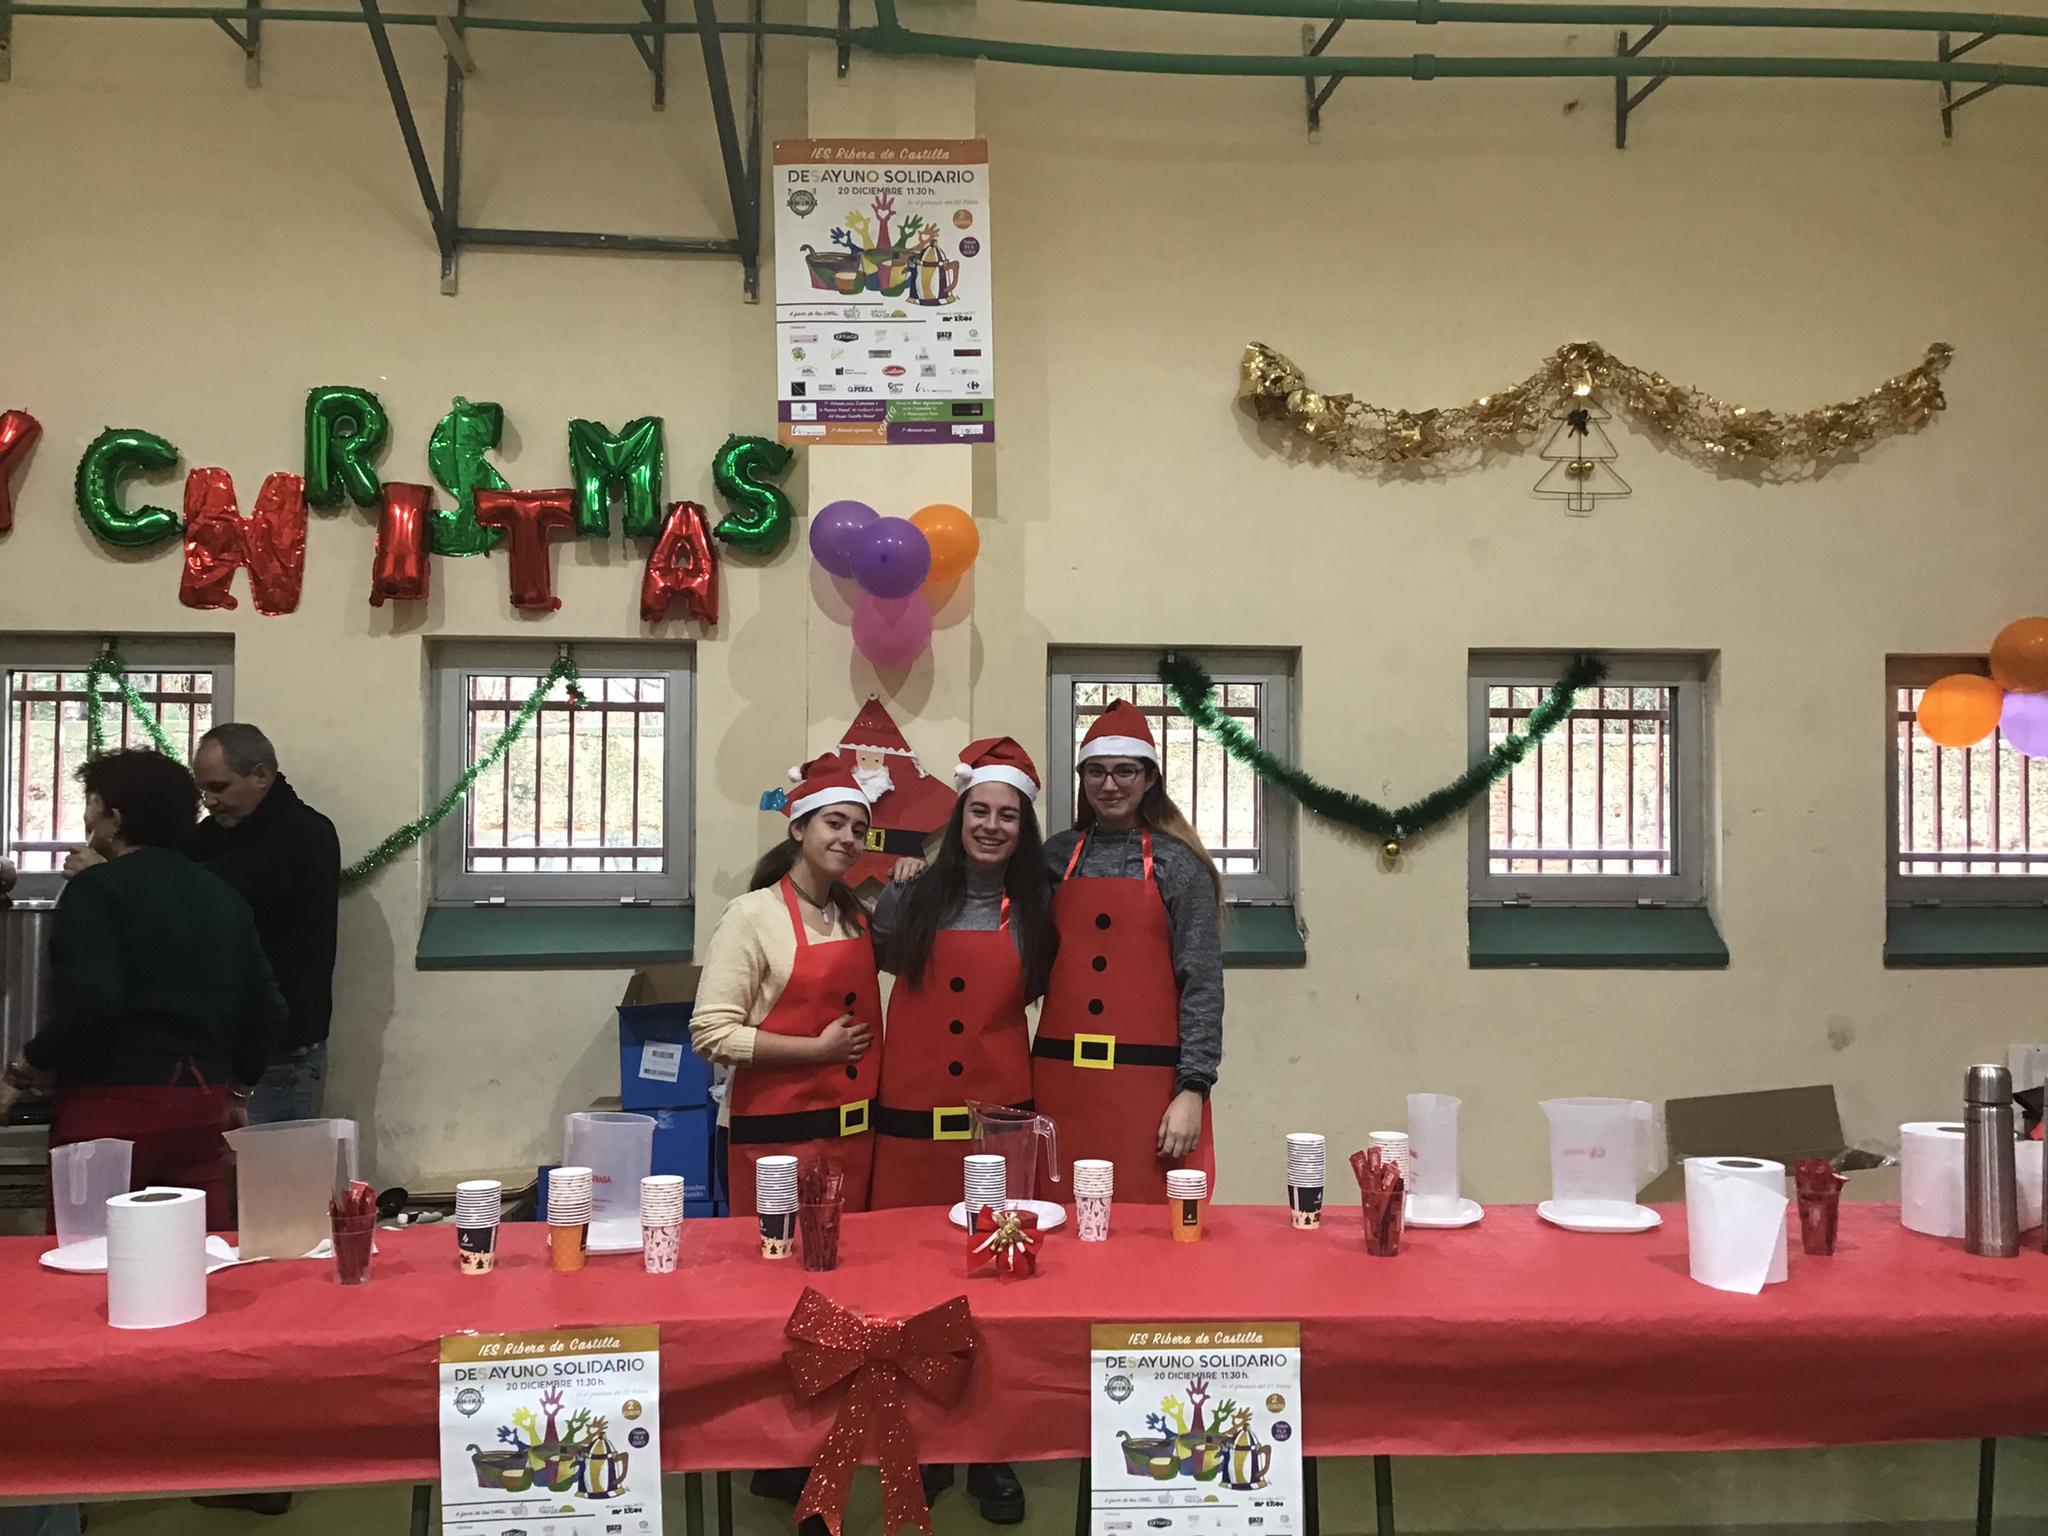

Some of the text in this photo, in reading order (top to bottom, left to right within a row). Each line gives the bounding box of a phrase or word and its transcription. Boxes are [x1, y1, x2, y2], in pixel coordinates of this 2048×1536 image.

[811, 148, 951, 160] IES Ribera de Castilla
[787, 169, 975, 184] DESAYUNO SOLIDARIO
[838, 187, 850, 196] 20
[852, 187, 903, 196] DICIEMBRE
[1128, 1331, 1264, 1345] IES Ribera de Castilla
[478, 1336, 621, 1357] IES Ribera de Castilla
[1105, 1353, 1288, 1369] DESAYUNO SOLIDARIO
[454, 1358, 645, 1382] DESAYUNO SOLIDARIO
[1154, 1371, 1166, 1380] 20
[1167, 1371, 1218, 1380] DICIEMBRE
[506, 1382, 518, 1391] 20
[520, 1379, 573, 1391] DICIEMBRE
